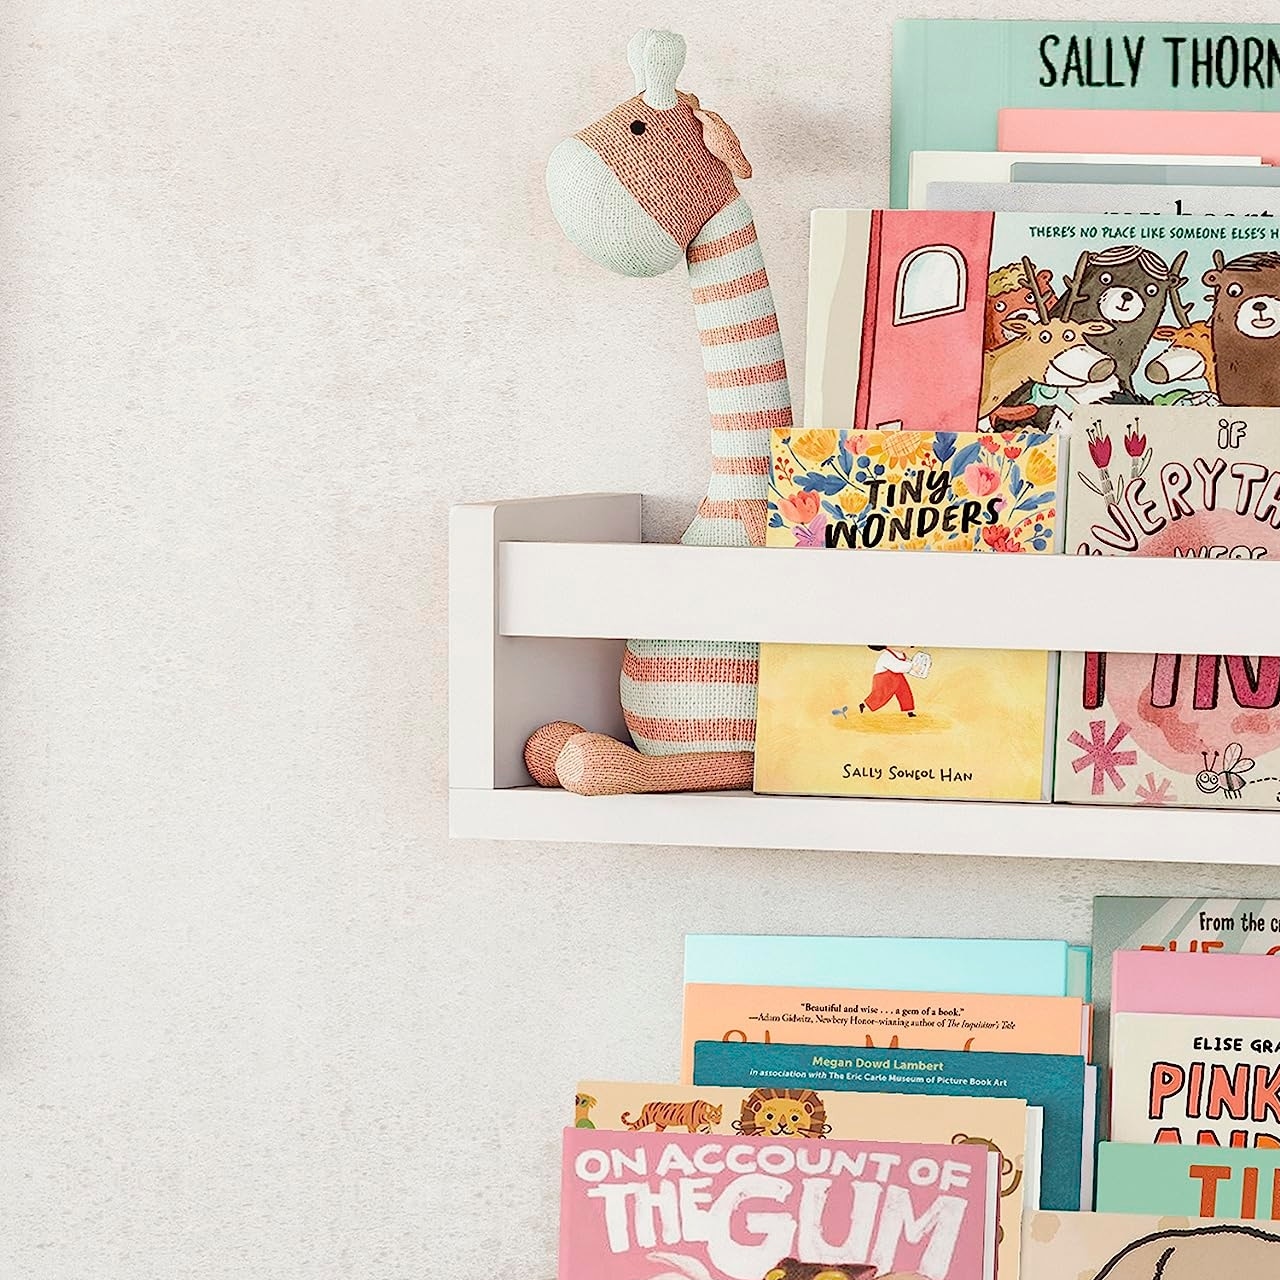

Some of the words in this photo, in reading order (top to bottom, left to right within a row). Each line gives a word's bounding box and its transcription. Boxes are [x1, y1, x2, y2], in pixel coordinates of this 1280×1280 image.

[1039, 34, 1144, 88] SALLY
[1029, 226, 1075, 238] THERE'S
[1080, 226, 1097, 238] NO
[1102, 226, 1136, 239] PLACE
[1141, 227, 1166, 239] LIKE
[1170, 227, 1227, 239] SOMEONE
[1232, 228, 1266, 240] ELSE'S
[866, 466, 953, 508] TINY
[825, 499, 1003, 549] WONDERS
[1199, 911, 1235, 931] From
[1241, 912, 1265, 932] the
[844, 1004, 859, 1013] and
[861, 1005, 879, 1014] wise
[902, 1008, 920, 1017] gem
[921, 1006, 932, 1016] of
[911, 1018, 935, 1027] author
[937, 1018, 946, 1028] of
[948, 1018, 960, 1028] The
[1193, 1036, 1244, 1051] ELISE
[812, 1056, 853, 1069] Megan
[856, 1058, 891, 1070] Dowd
[893, 1060, 945, 1072] Lambert
[759, 1069, 807, 1079] association
[808, 1070, 827, 1080] with
[828, 1071, 845, 1080] The
[846, 1072, 863, 1081] Eric
[863, 1073, 888, 1082] Carle
[888, 1074, 925, 1083] Museum
[926, 1075, 935, 1084] of
[936, 1075, 968, 1085] Picture
[969, 1077, 992, 1087] Book
[993, 1078, 1009, 1087] Art
[574, 1145, 647, 1183] ON
[656, 1144, 902, 1179] ACCOUNT
[908, 1158, 972, 1191] OF
[586, 1176, 714, 1254] THE
